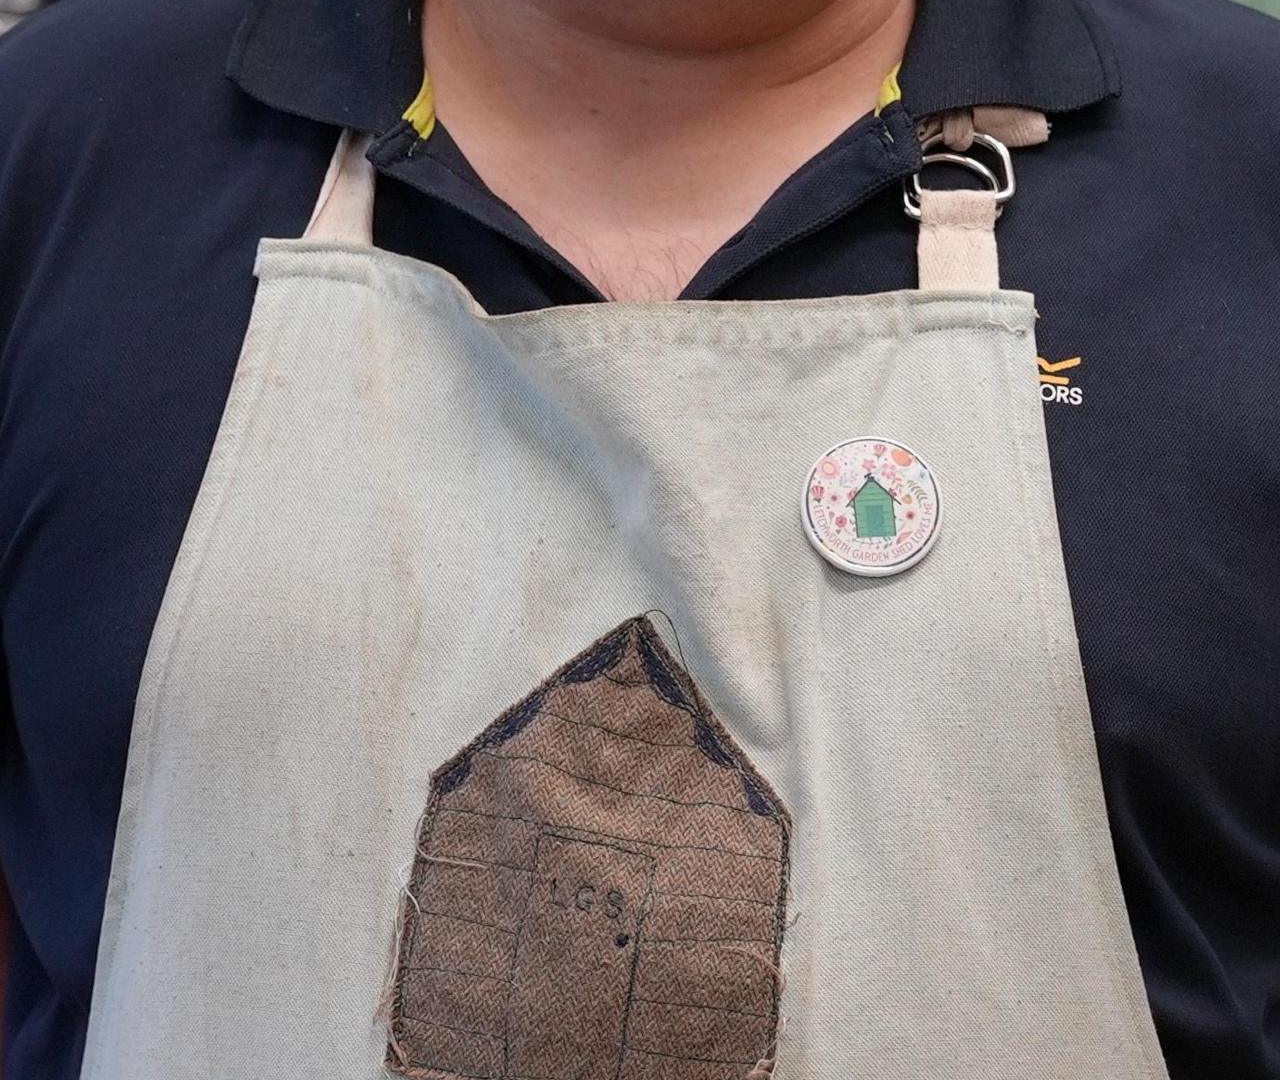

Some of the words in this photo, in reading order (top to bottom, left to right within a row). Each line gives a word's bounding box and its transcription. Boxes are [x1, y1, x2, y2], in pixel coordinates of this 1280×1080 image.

[1040, 383, 1083, 405] ORS
[813, 503, 851, 554] LETCHWORTH
[852, 548, 889, 562] GARDEN
[891, 541, 913, 559] SHED
[923, 502, 934, 516] ME
